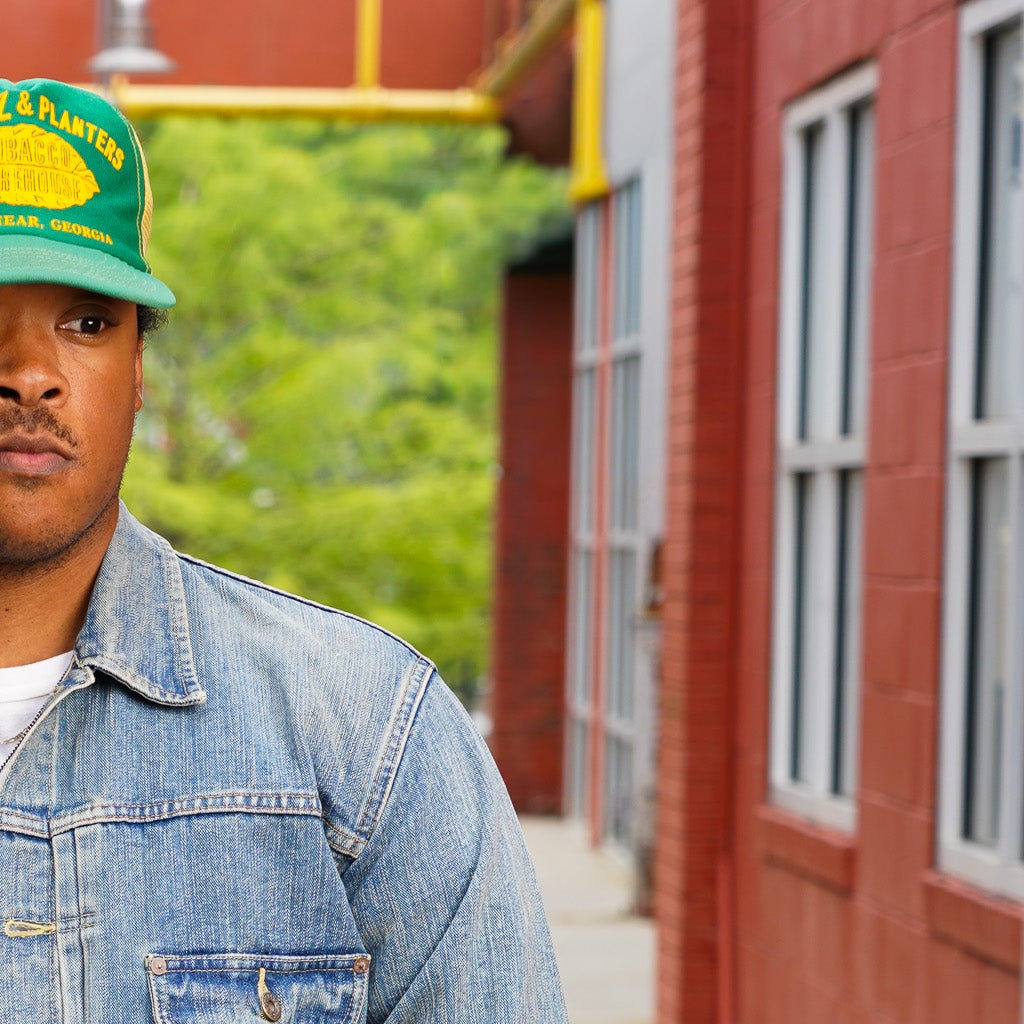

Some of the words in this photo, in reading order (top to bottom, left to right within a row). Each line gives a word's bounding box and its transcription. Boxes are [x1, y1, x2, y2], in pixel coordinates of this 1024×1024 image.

[16, 90, 34, 116] &
[38, 95, 124, 170] PLANTERS
[50, 218, 114, 246] GEORGIA
